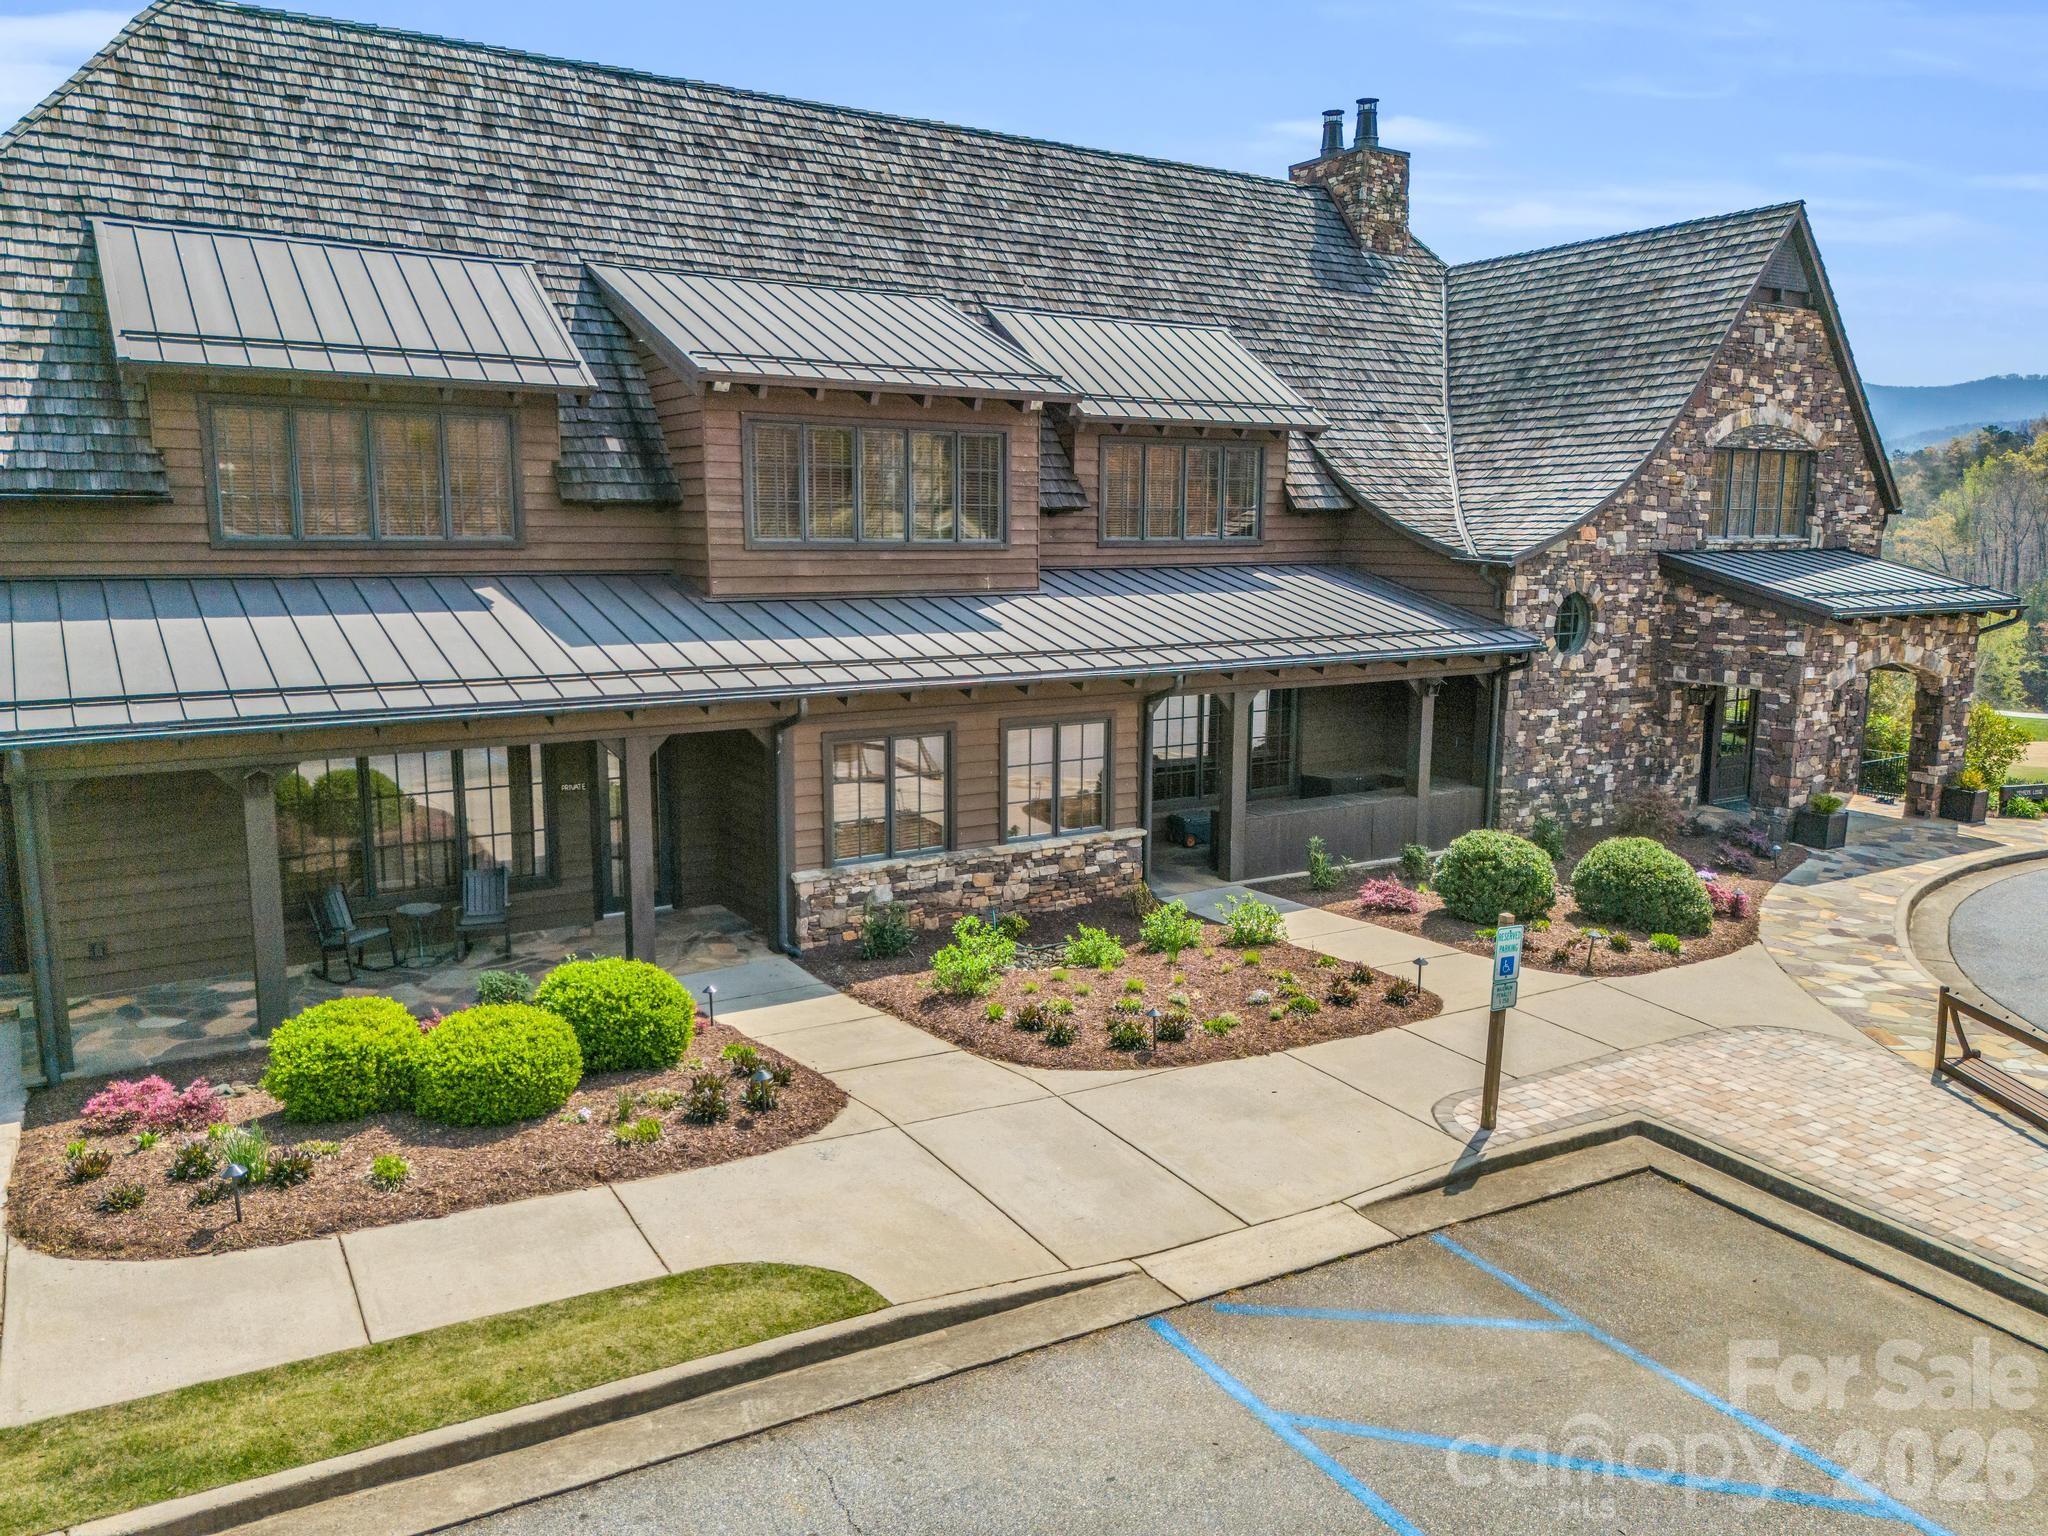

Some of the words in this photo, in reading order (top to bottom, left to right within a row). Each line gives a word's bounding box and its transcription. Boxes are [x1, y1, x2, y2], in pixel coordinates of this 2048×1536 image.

[561, 783, 586, 791] PRIVATE
[1499, 931, 1521, 941] RESERVED
[1499, 943, 1518, 953] PARKING
